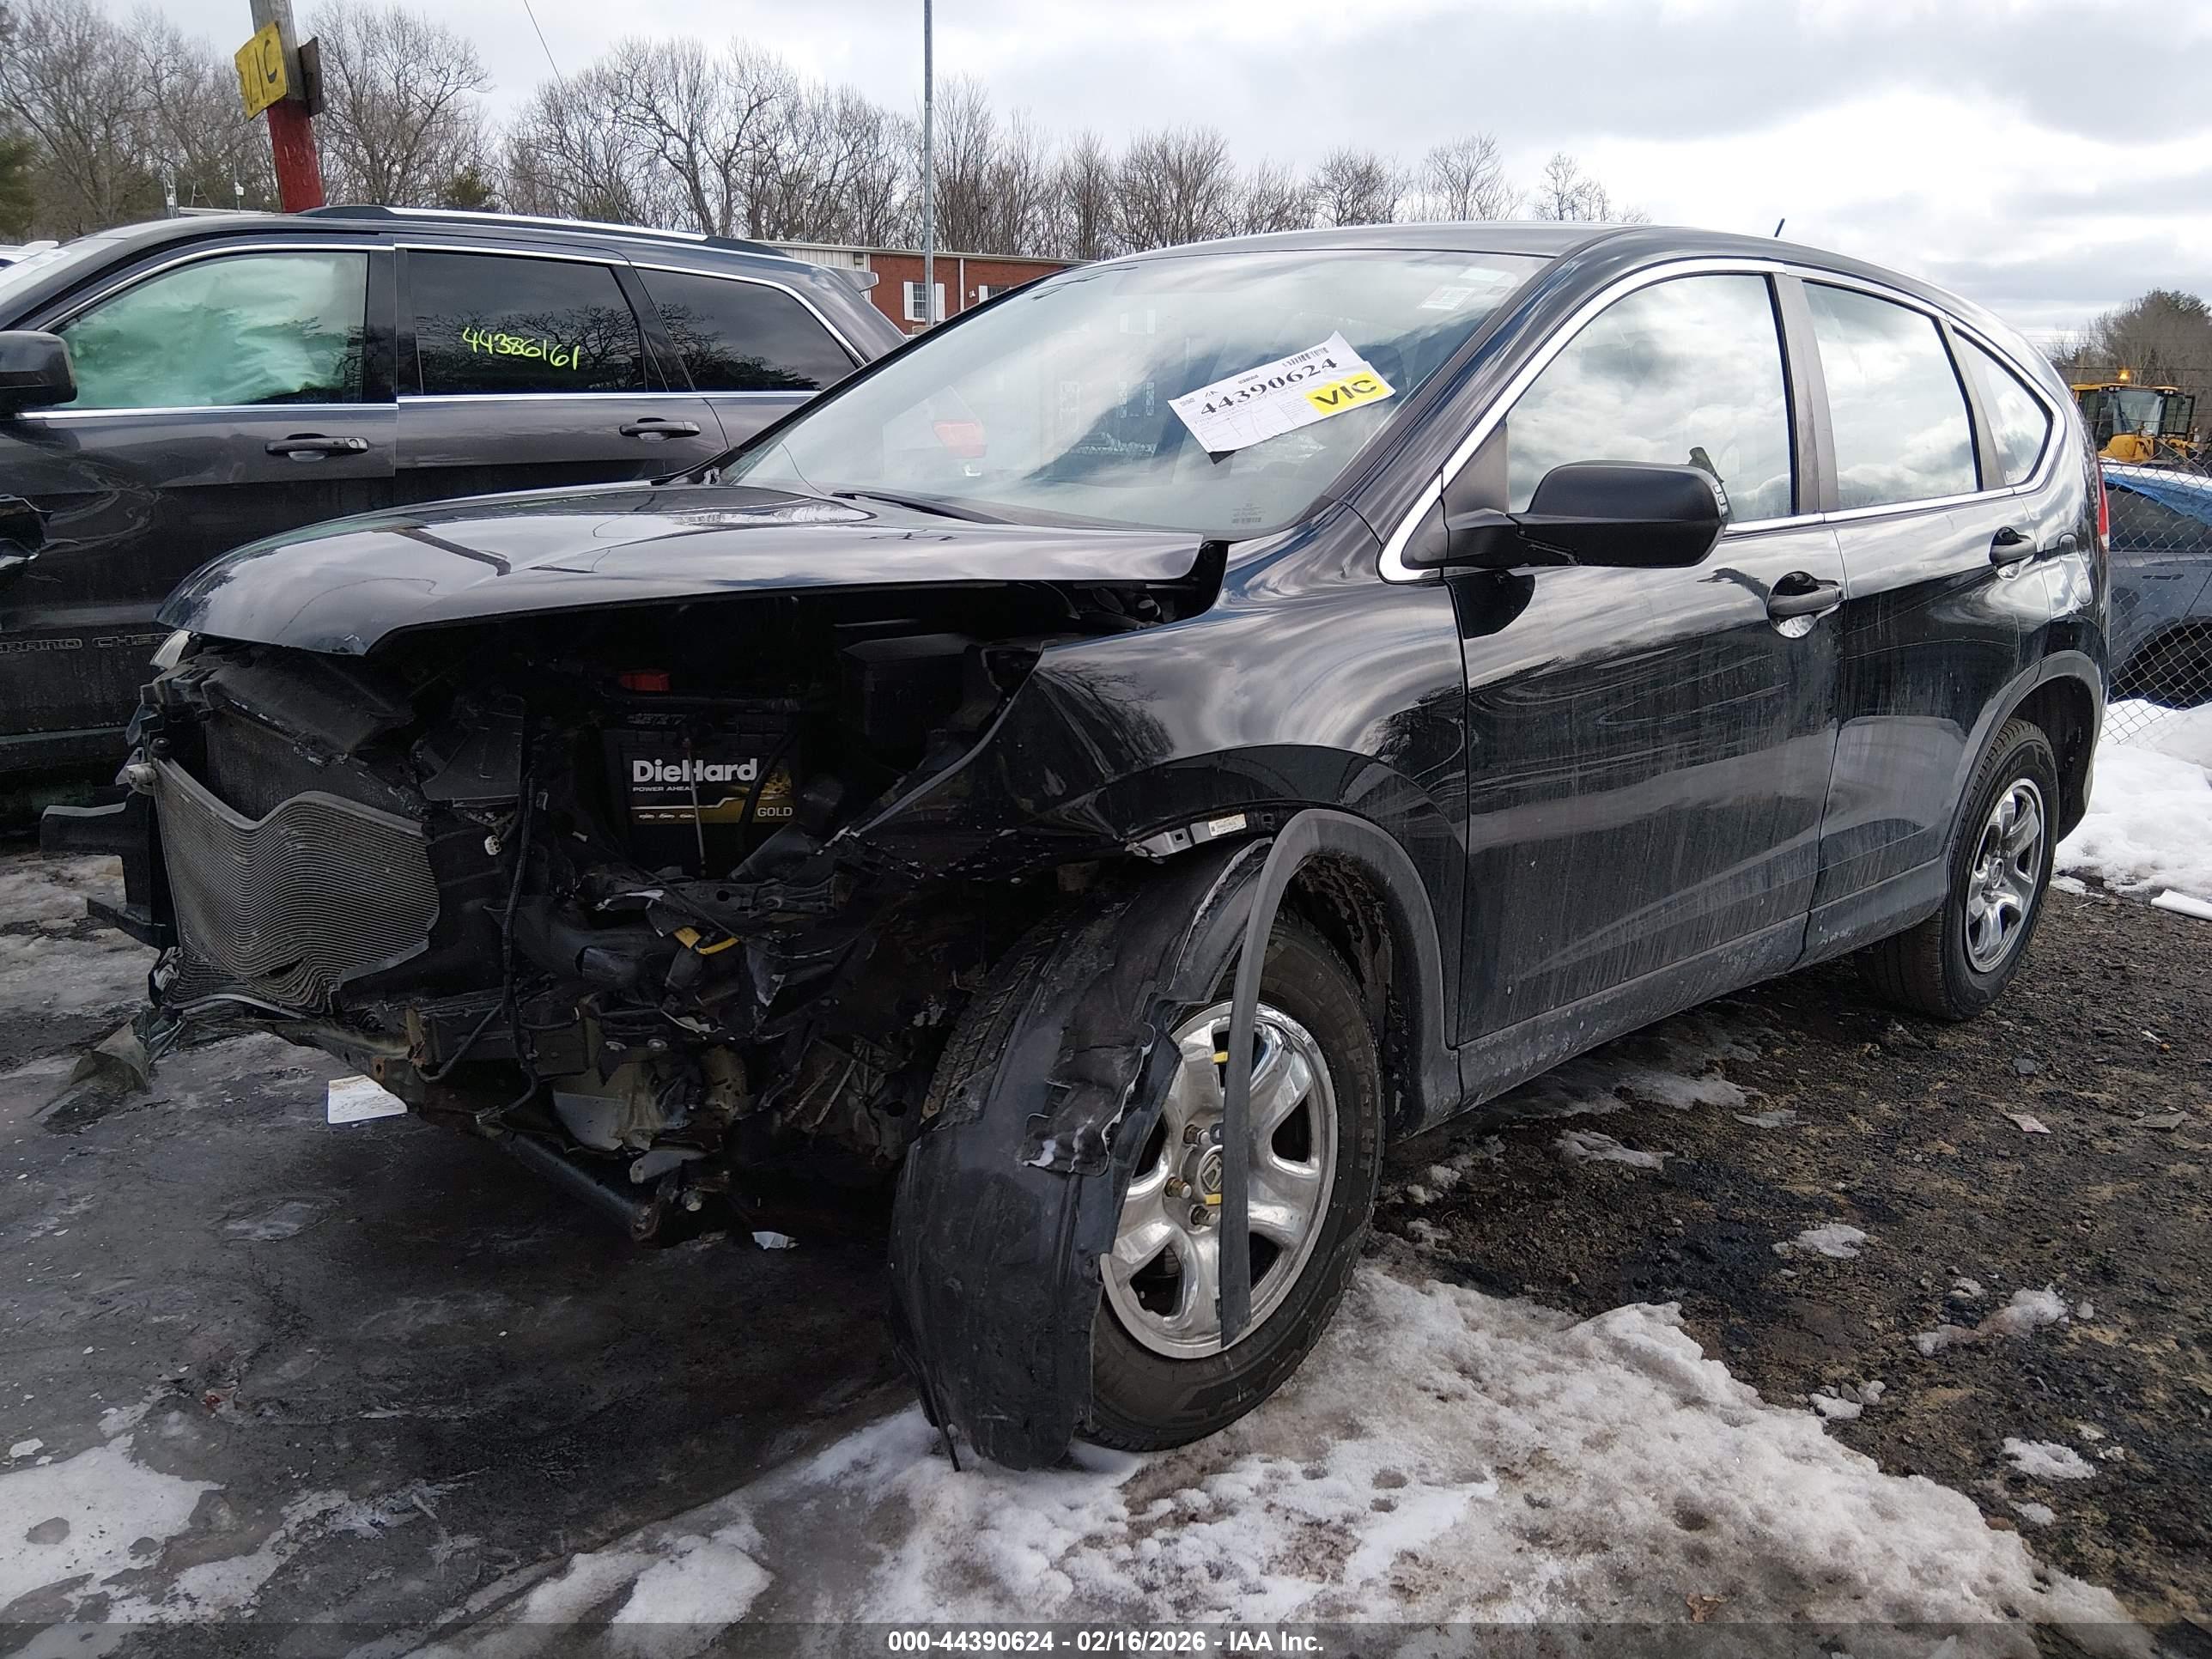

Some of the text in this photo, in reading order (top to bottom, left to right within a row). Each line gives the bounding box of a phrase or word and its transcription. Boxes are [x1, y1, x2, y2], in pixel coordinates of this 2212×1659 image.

[462, 326, 580, 370] 44386161
[1200, 356, 1339, 416] 44390624
[1312, 379, 1378, 406] VIC
[633, 758, 758, 783] DieHard
[757, 806, 793, 817] GOLD
